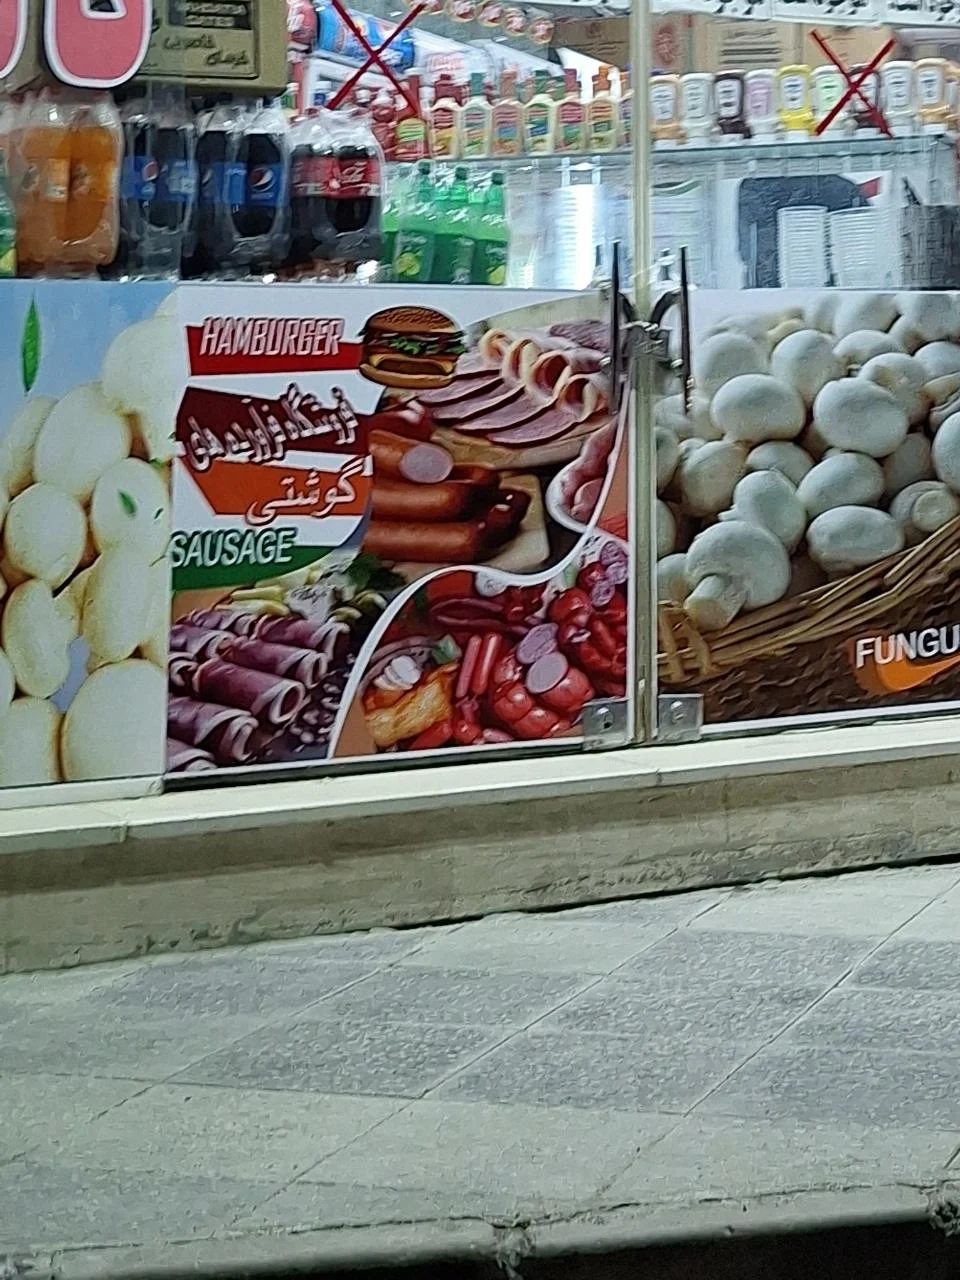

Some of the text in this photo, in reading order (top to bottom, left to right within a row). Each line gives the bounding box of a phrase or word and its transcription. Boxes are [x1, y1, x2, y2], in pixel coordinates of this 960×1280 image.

[199, 317, 344, 357] HAMBURGER
[283, 383, 359, 446] فروشگاه
[246, 457, 366, 526] گوشتی
[170, 528, 297, 568] SAUSAGE
